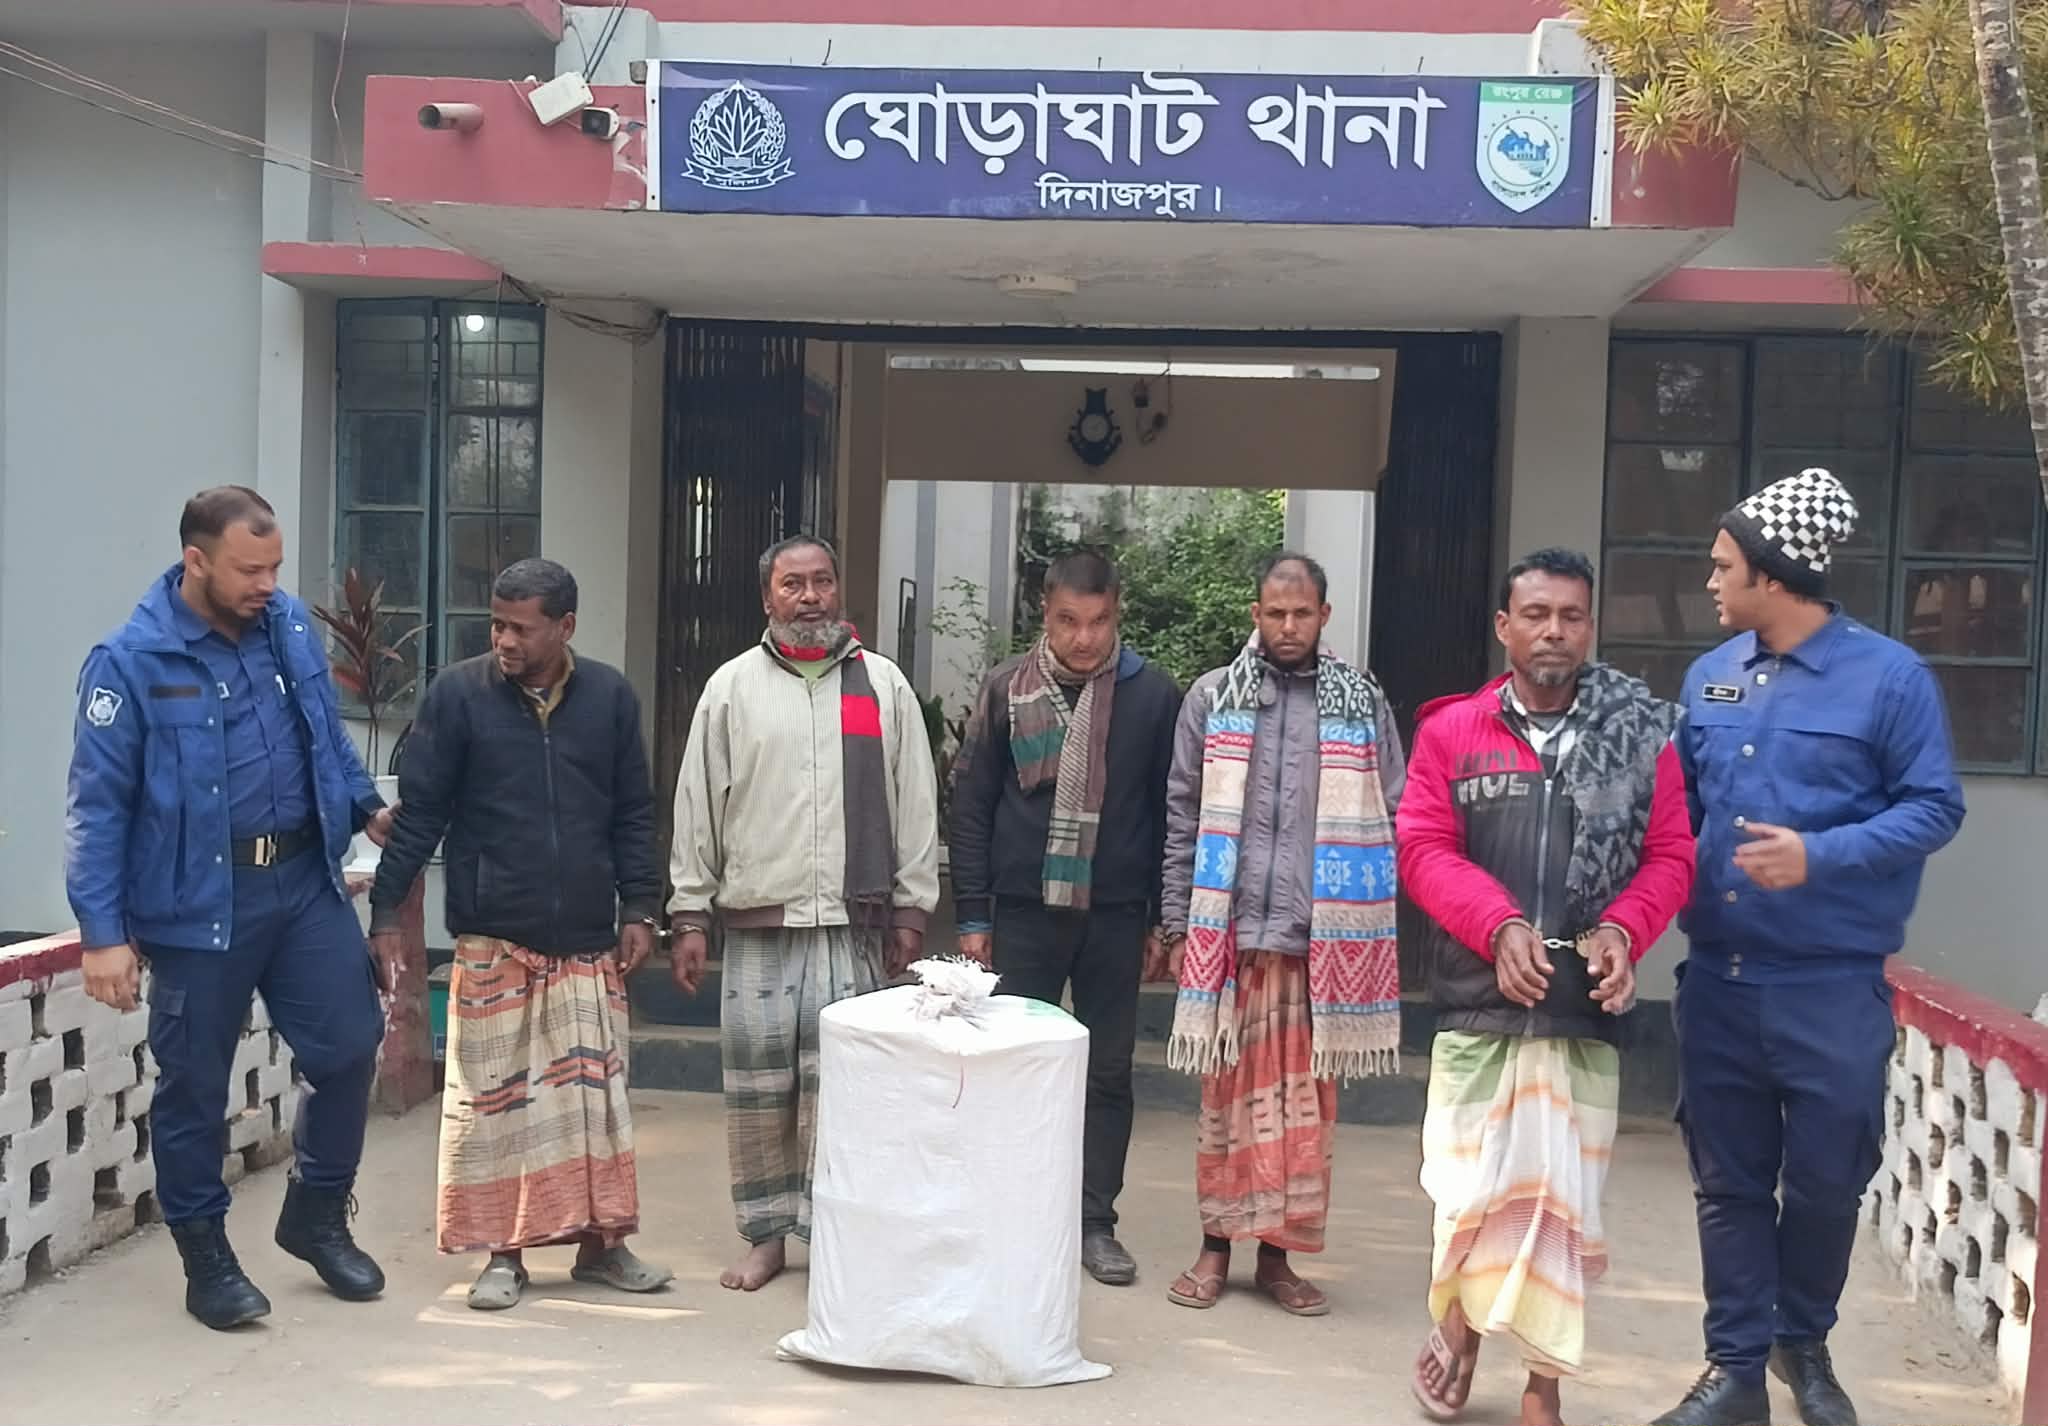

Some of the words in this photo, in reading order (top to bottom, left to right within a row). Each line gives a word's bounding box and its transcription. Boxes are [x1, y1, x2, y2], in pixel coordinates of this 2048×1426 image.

[825, 71, 1220, 175] ঘোড়াঘাট
[1247, 84, 1448, 170] থানা
[1034, 172, 1202, 218] দিনাজপুর
